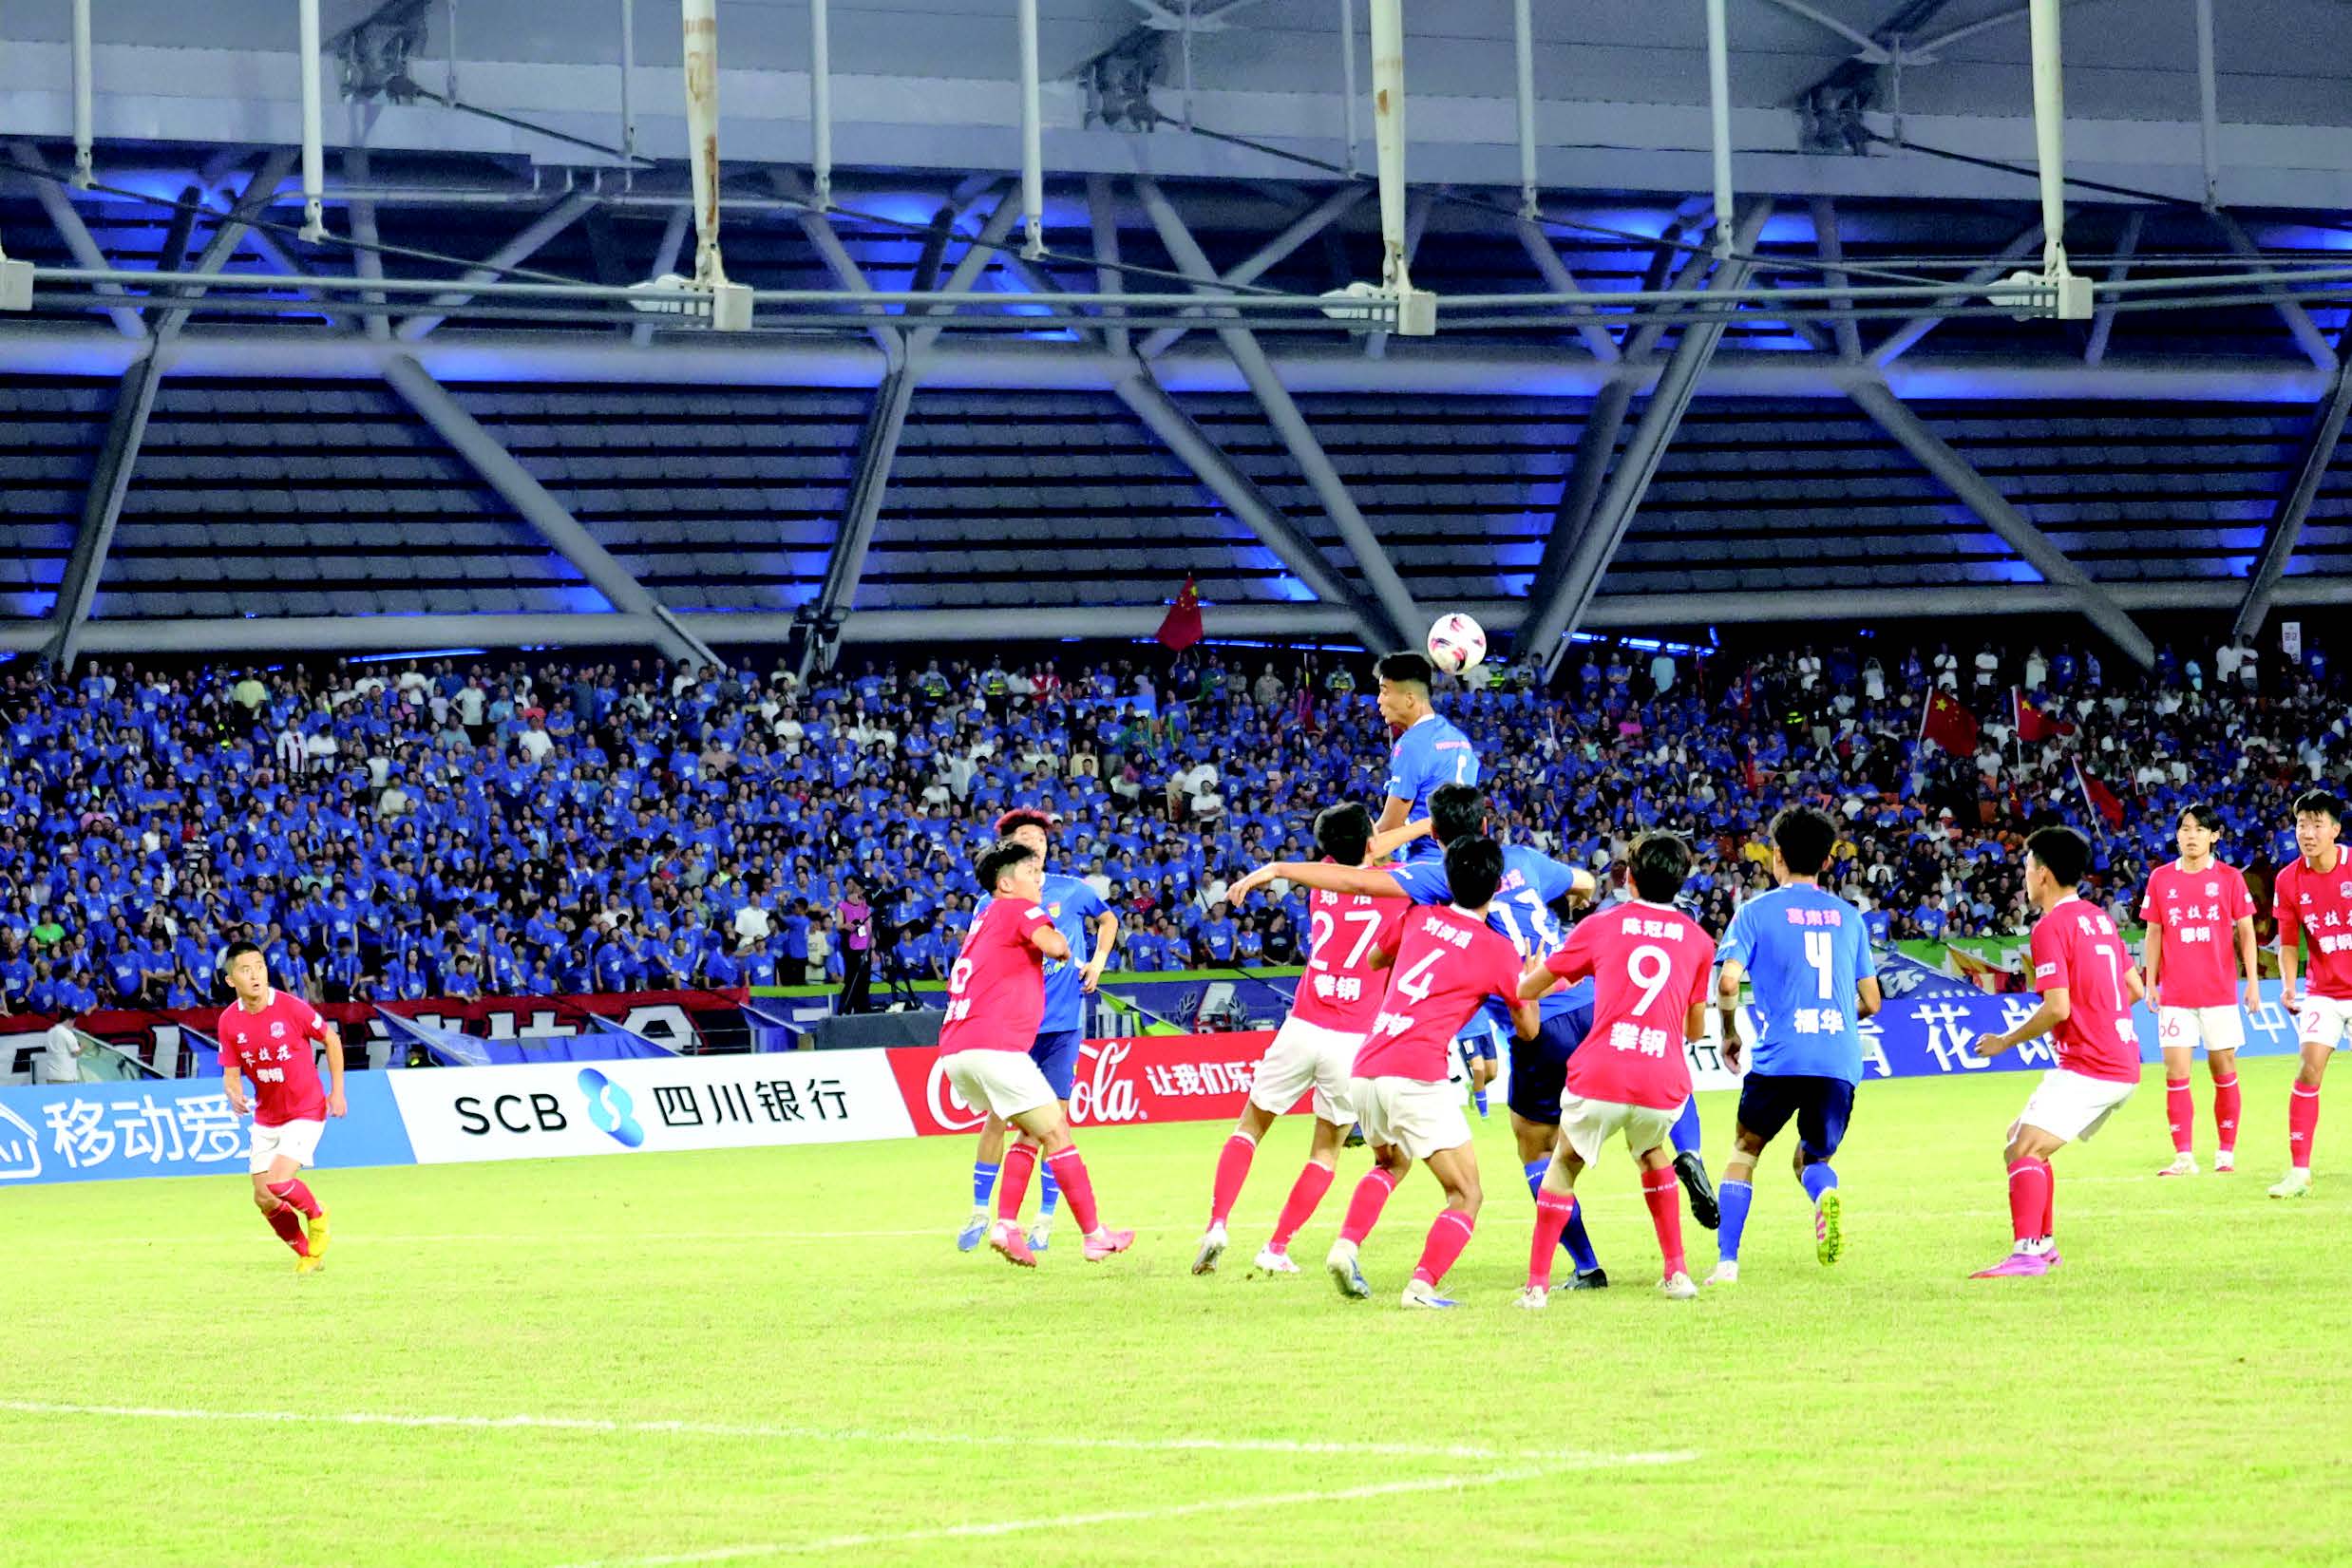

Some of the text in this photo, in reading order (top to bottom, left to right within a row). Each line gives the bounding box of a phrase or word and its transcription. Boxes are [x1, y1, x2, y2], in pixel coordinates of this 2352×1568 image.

[1310, 909, 1382, 972] 27
[1314, 973, 1361, 1001] 攀钢
[1397, 948, 1447, 1007] 4
[1627, 944, 1672, 1017] 9
[1804, 931, 1833, 1000] 4
[2095, 944, 2123, 1011] 7
[1609, 1021, 1667, 1058] 攀钢
[1793, 1008, 1845, 1035] 福华
[1145, 1059, 1261, 1096] 让我们乐
[454, 1094, 567, 1136] SCB
[654, 1079, 848, 1127] 四川银行
